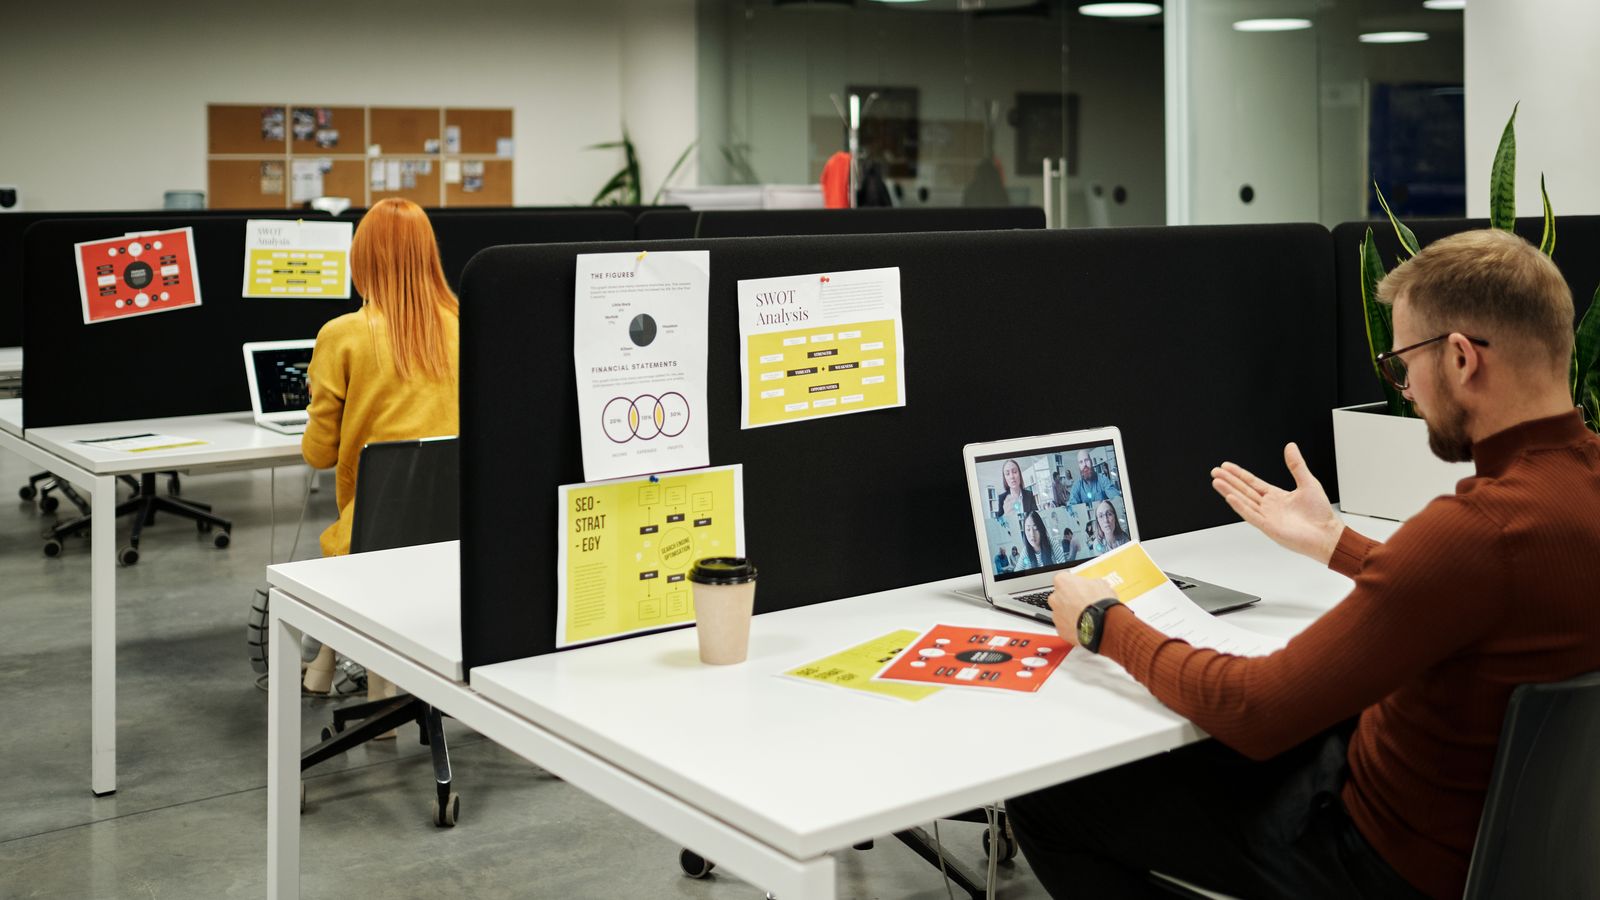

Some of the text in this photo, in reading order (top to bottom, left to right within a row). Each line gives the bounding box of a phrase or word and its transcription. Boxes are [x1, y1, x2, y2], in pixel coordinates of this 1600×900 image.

[605, 271, 635, 279] FIGURES
[756, 289, 796, 307] SWOT
[756, 307, 809, 326] Analysis
[591, 360, 678, 374] FINANCIAL STATEMENTS
[575, 496, 594, 512] SEO
[575, 514, 606, 533] STRAT
[582, 535, 601, 552] EGY
